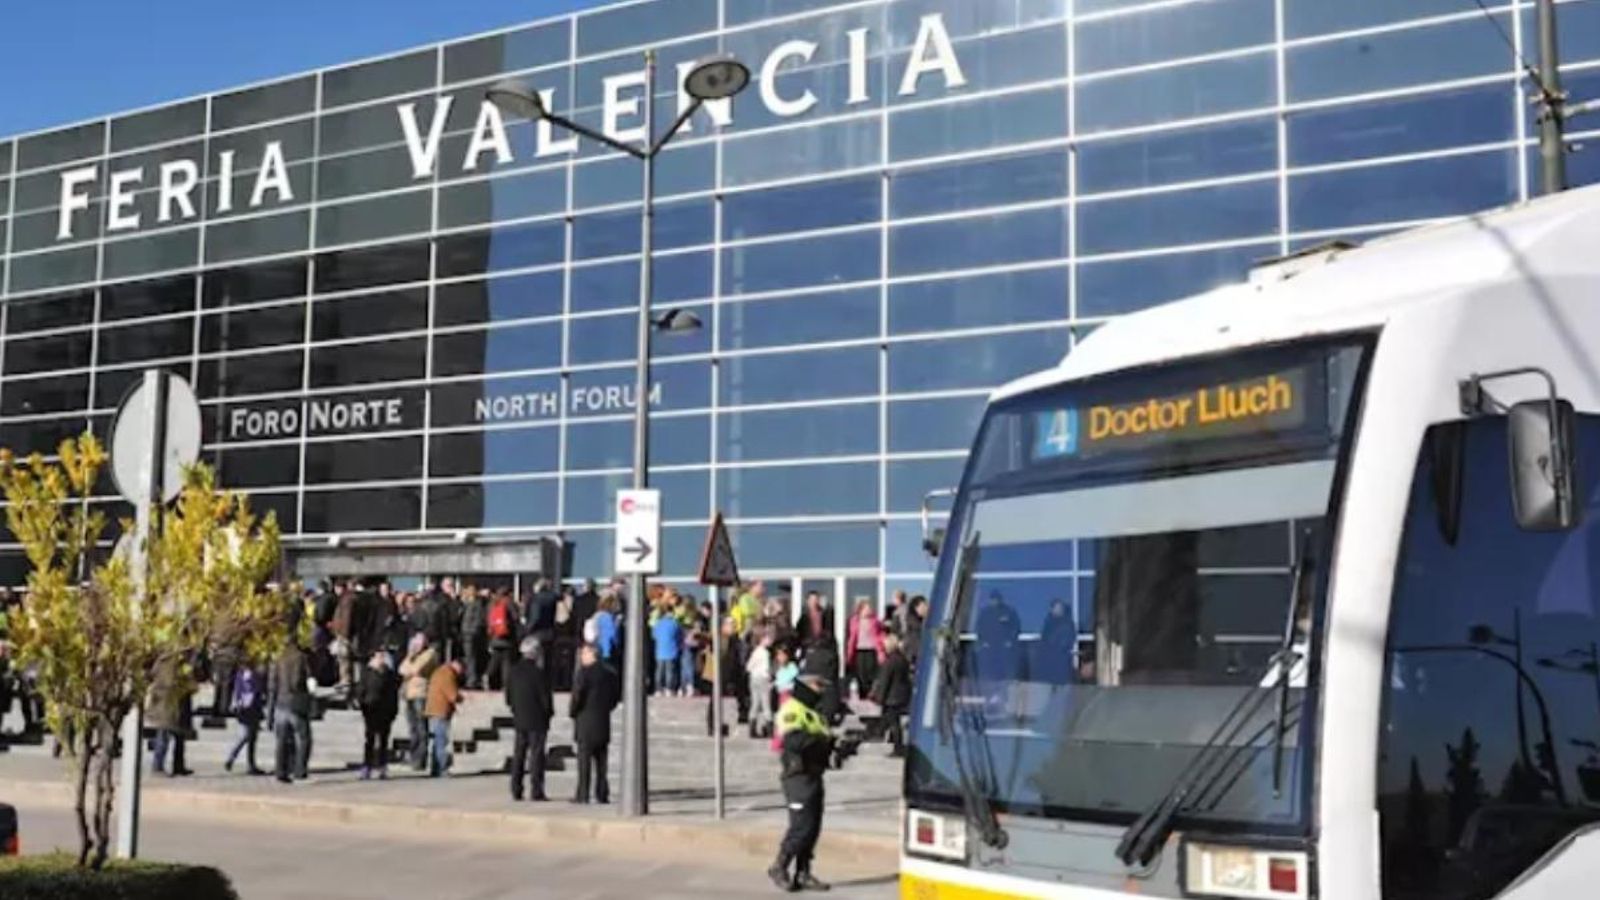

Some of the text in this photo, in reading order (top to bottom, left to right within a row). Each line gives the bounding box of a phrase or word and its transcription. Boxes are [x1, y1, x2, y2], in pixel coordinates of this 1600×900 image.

[56, 141, 294, 239] FERIA
[230, 398, 403, 438] FORO NORTE
[475, 388, 557, 421] NORTH
[1046, 374, 1292, 453] 4 Doctor Lluch
